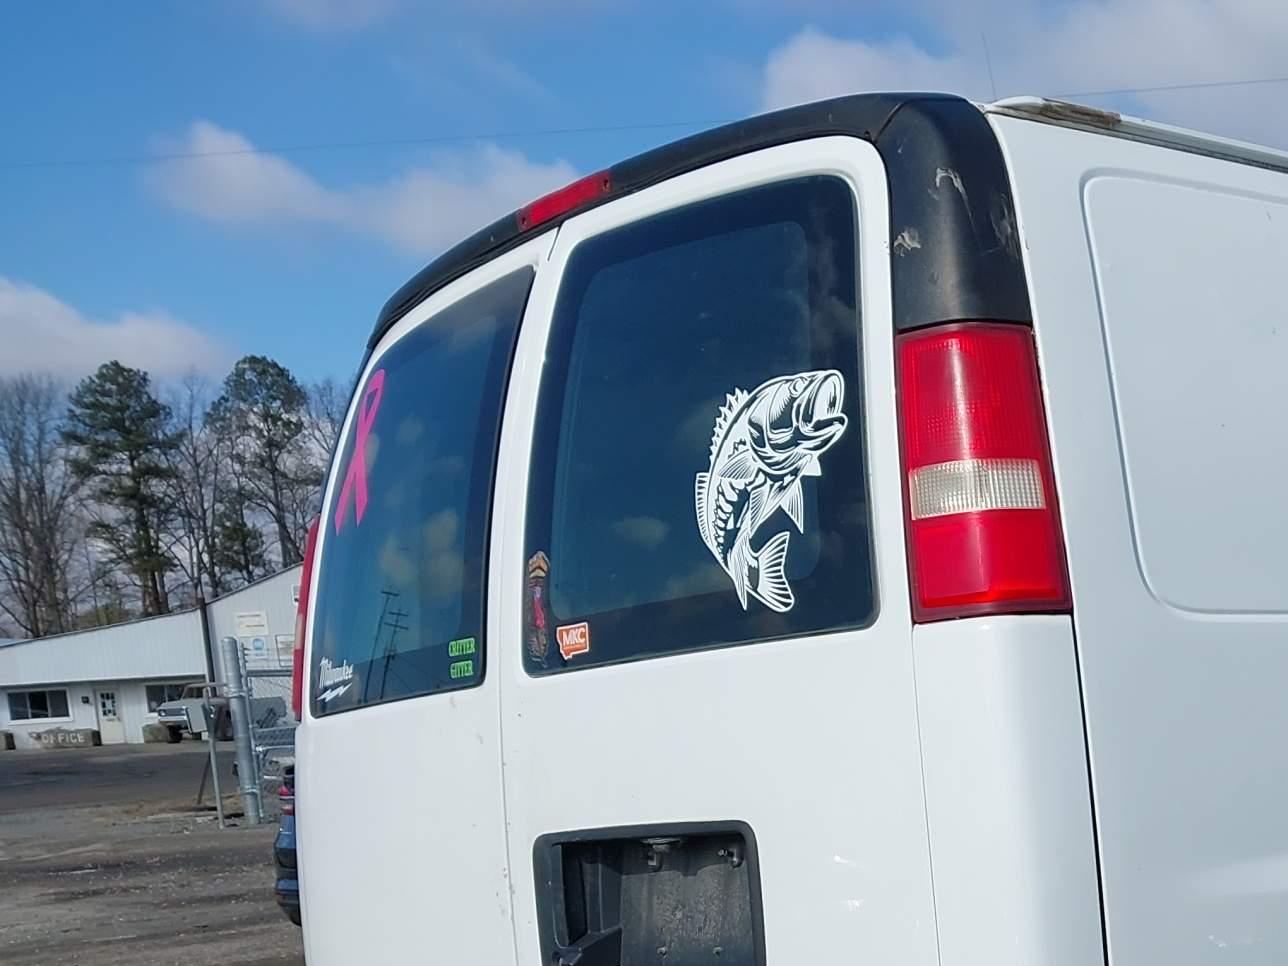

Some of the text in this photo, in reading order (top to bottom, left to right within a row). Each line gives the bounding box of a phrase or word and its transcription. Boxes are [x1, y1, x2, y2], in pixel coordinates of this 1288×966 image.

[562, 627, 586, 646] MKC
[447, 637, 476, 657] CRITTER
[449, 659, 475, 680] GITTER
[41, 732, 86, 744] OFFICE
